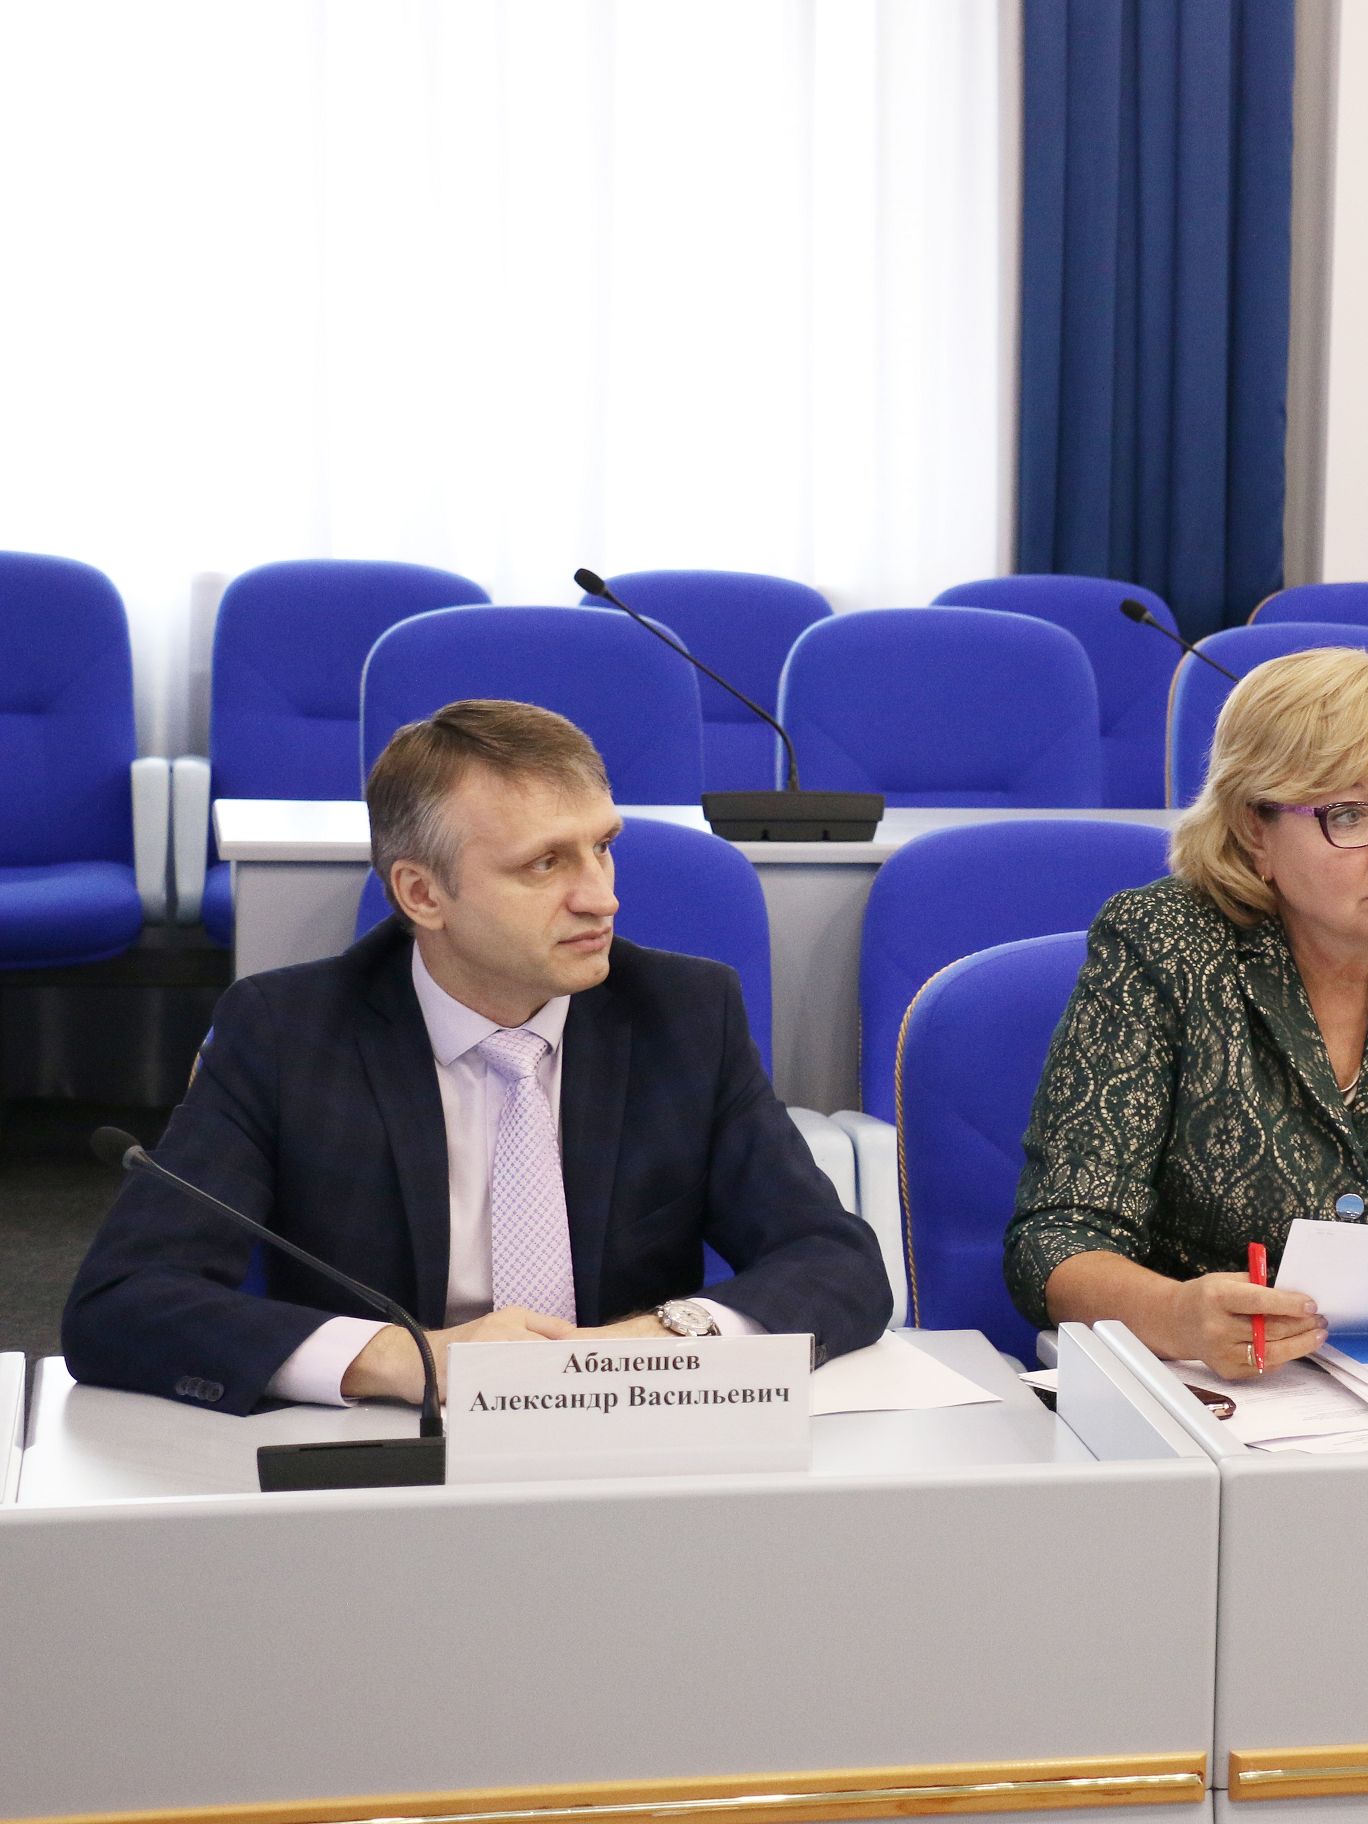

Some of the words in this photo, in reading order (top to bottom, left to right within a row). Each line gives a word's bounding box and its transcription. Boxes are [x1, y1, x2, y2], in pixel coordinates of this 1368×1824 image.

[562, 1351, 701, 1374] Абалешев
[468, 1390, 619, 1414] Александр
[628, 1385, 791, 1408] Васильевич
